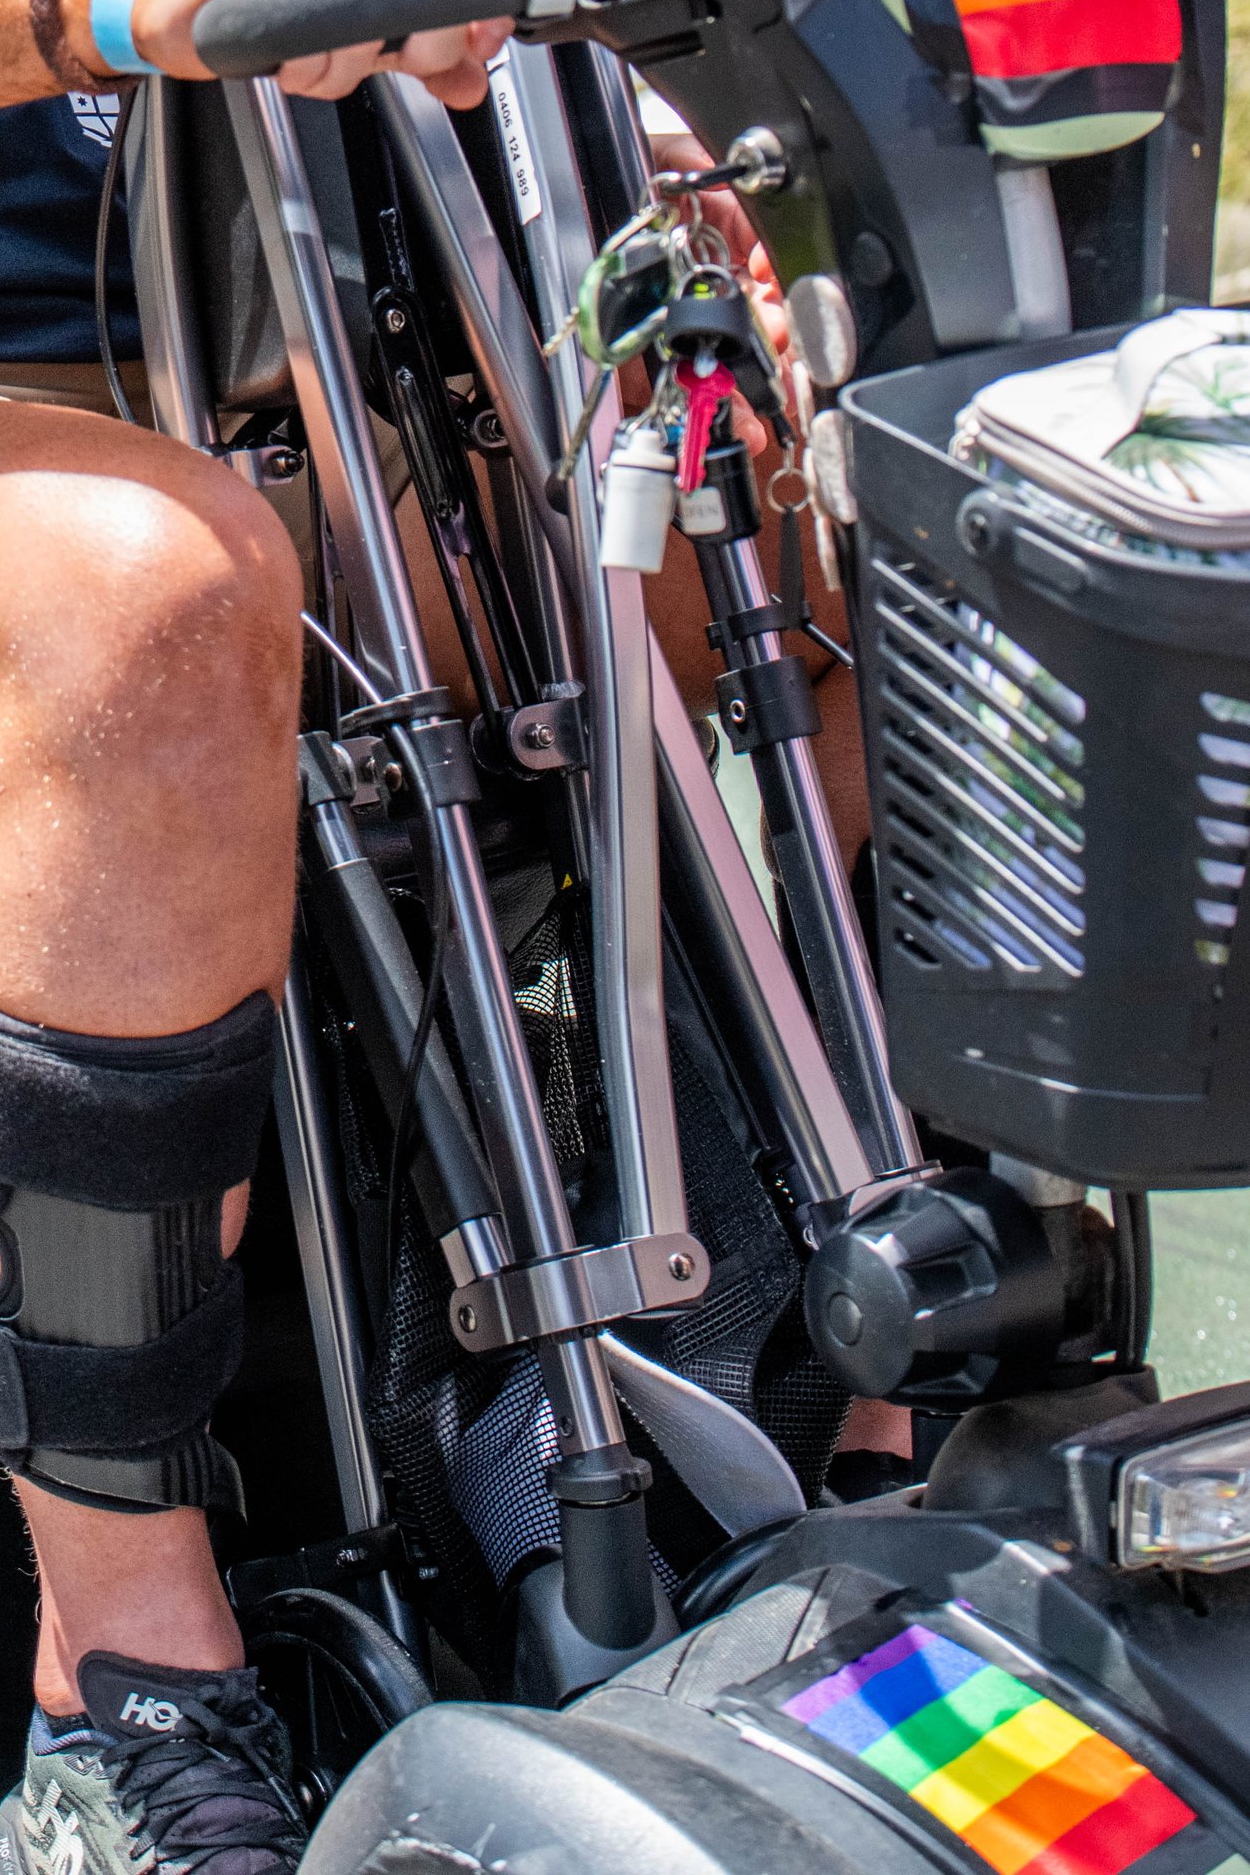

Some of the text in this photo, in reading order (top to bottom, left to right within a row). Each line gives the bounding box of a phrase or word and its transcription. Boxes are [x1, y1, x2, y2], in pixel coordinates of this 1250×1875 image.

[498, 92, 529, 197] 0406 124 989
[119, 1691, 184, 1733] HO
